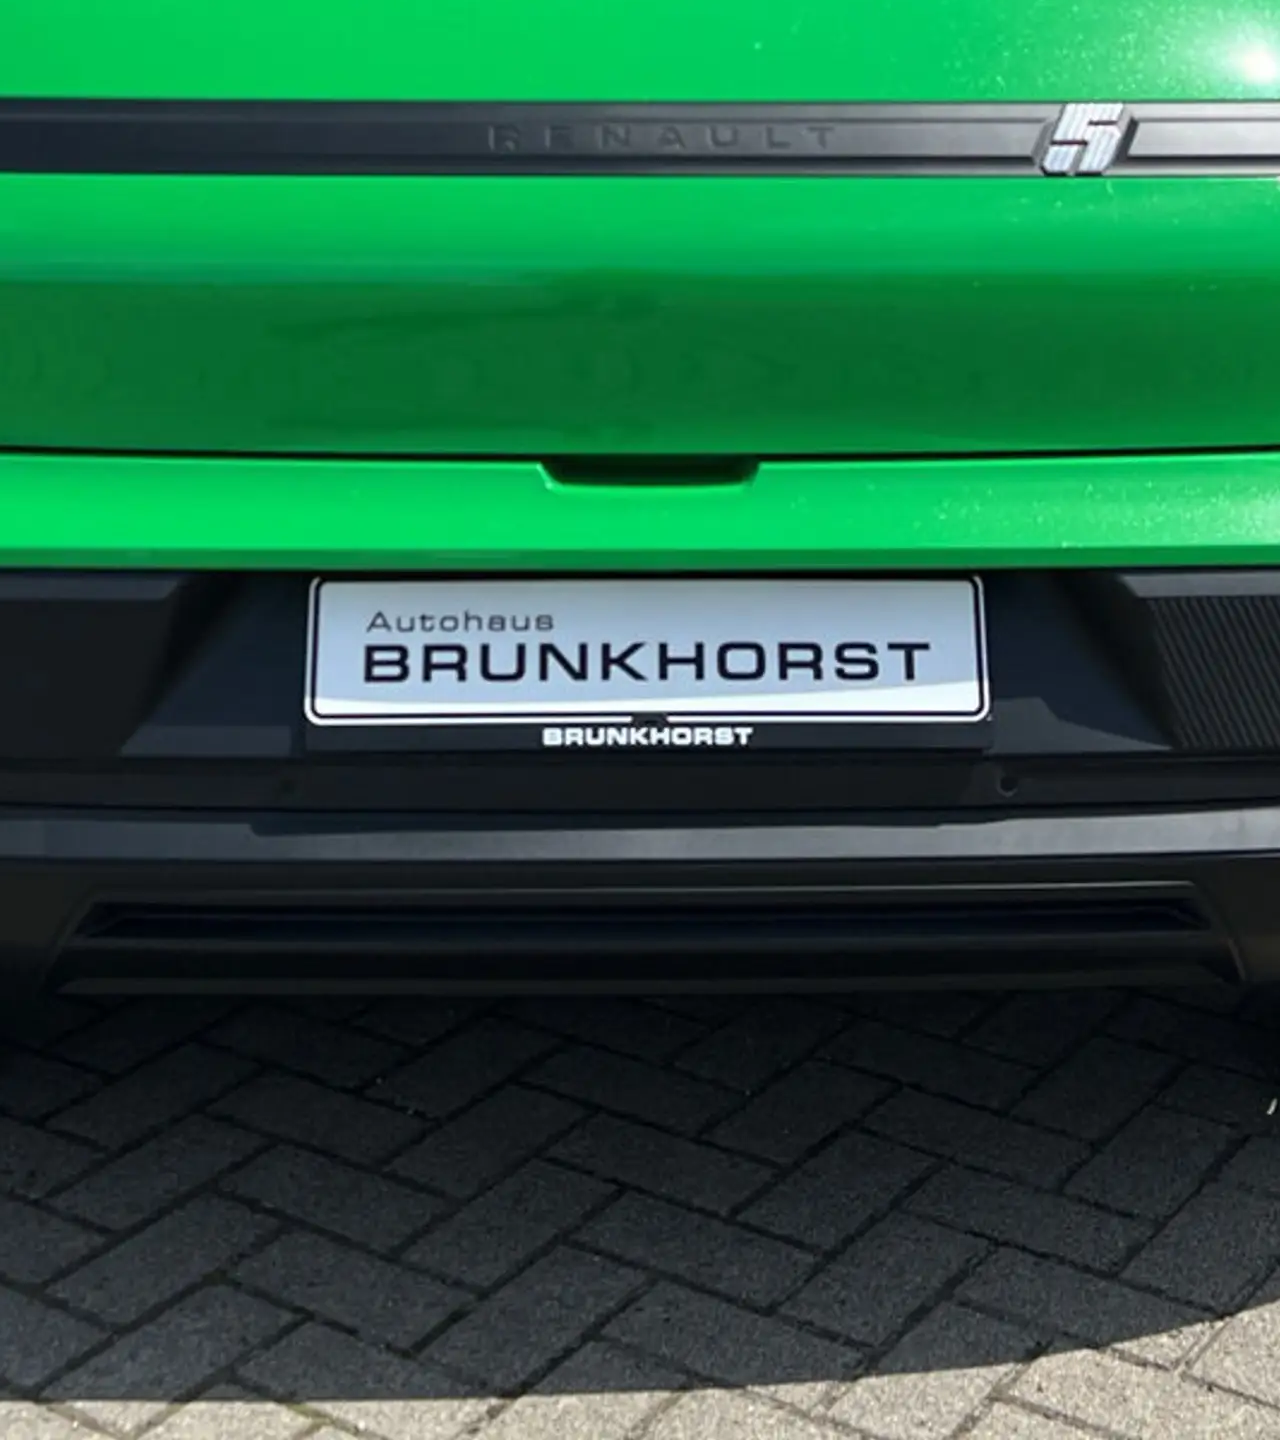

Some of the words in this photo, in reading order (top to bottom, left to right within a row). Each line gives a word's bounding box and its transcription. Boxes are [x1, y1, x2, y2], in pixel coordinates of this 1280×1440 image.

[487, 124, 836, 151] RENAULT
[366, 609, 555, 633] Autohaus
[364, 641, 931, 683] BRUNKHORST
[542, 726, 754, 747] BRUNKHORST
